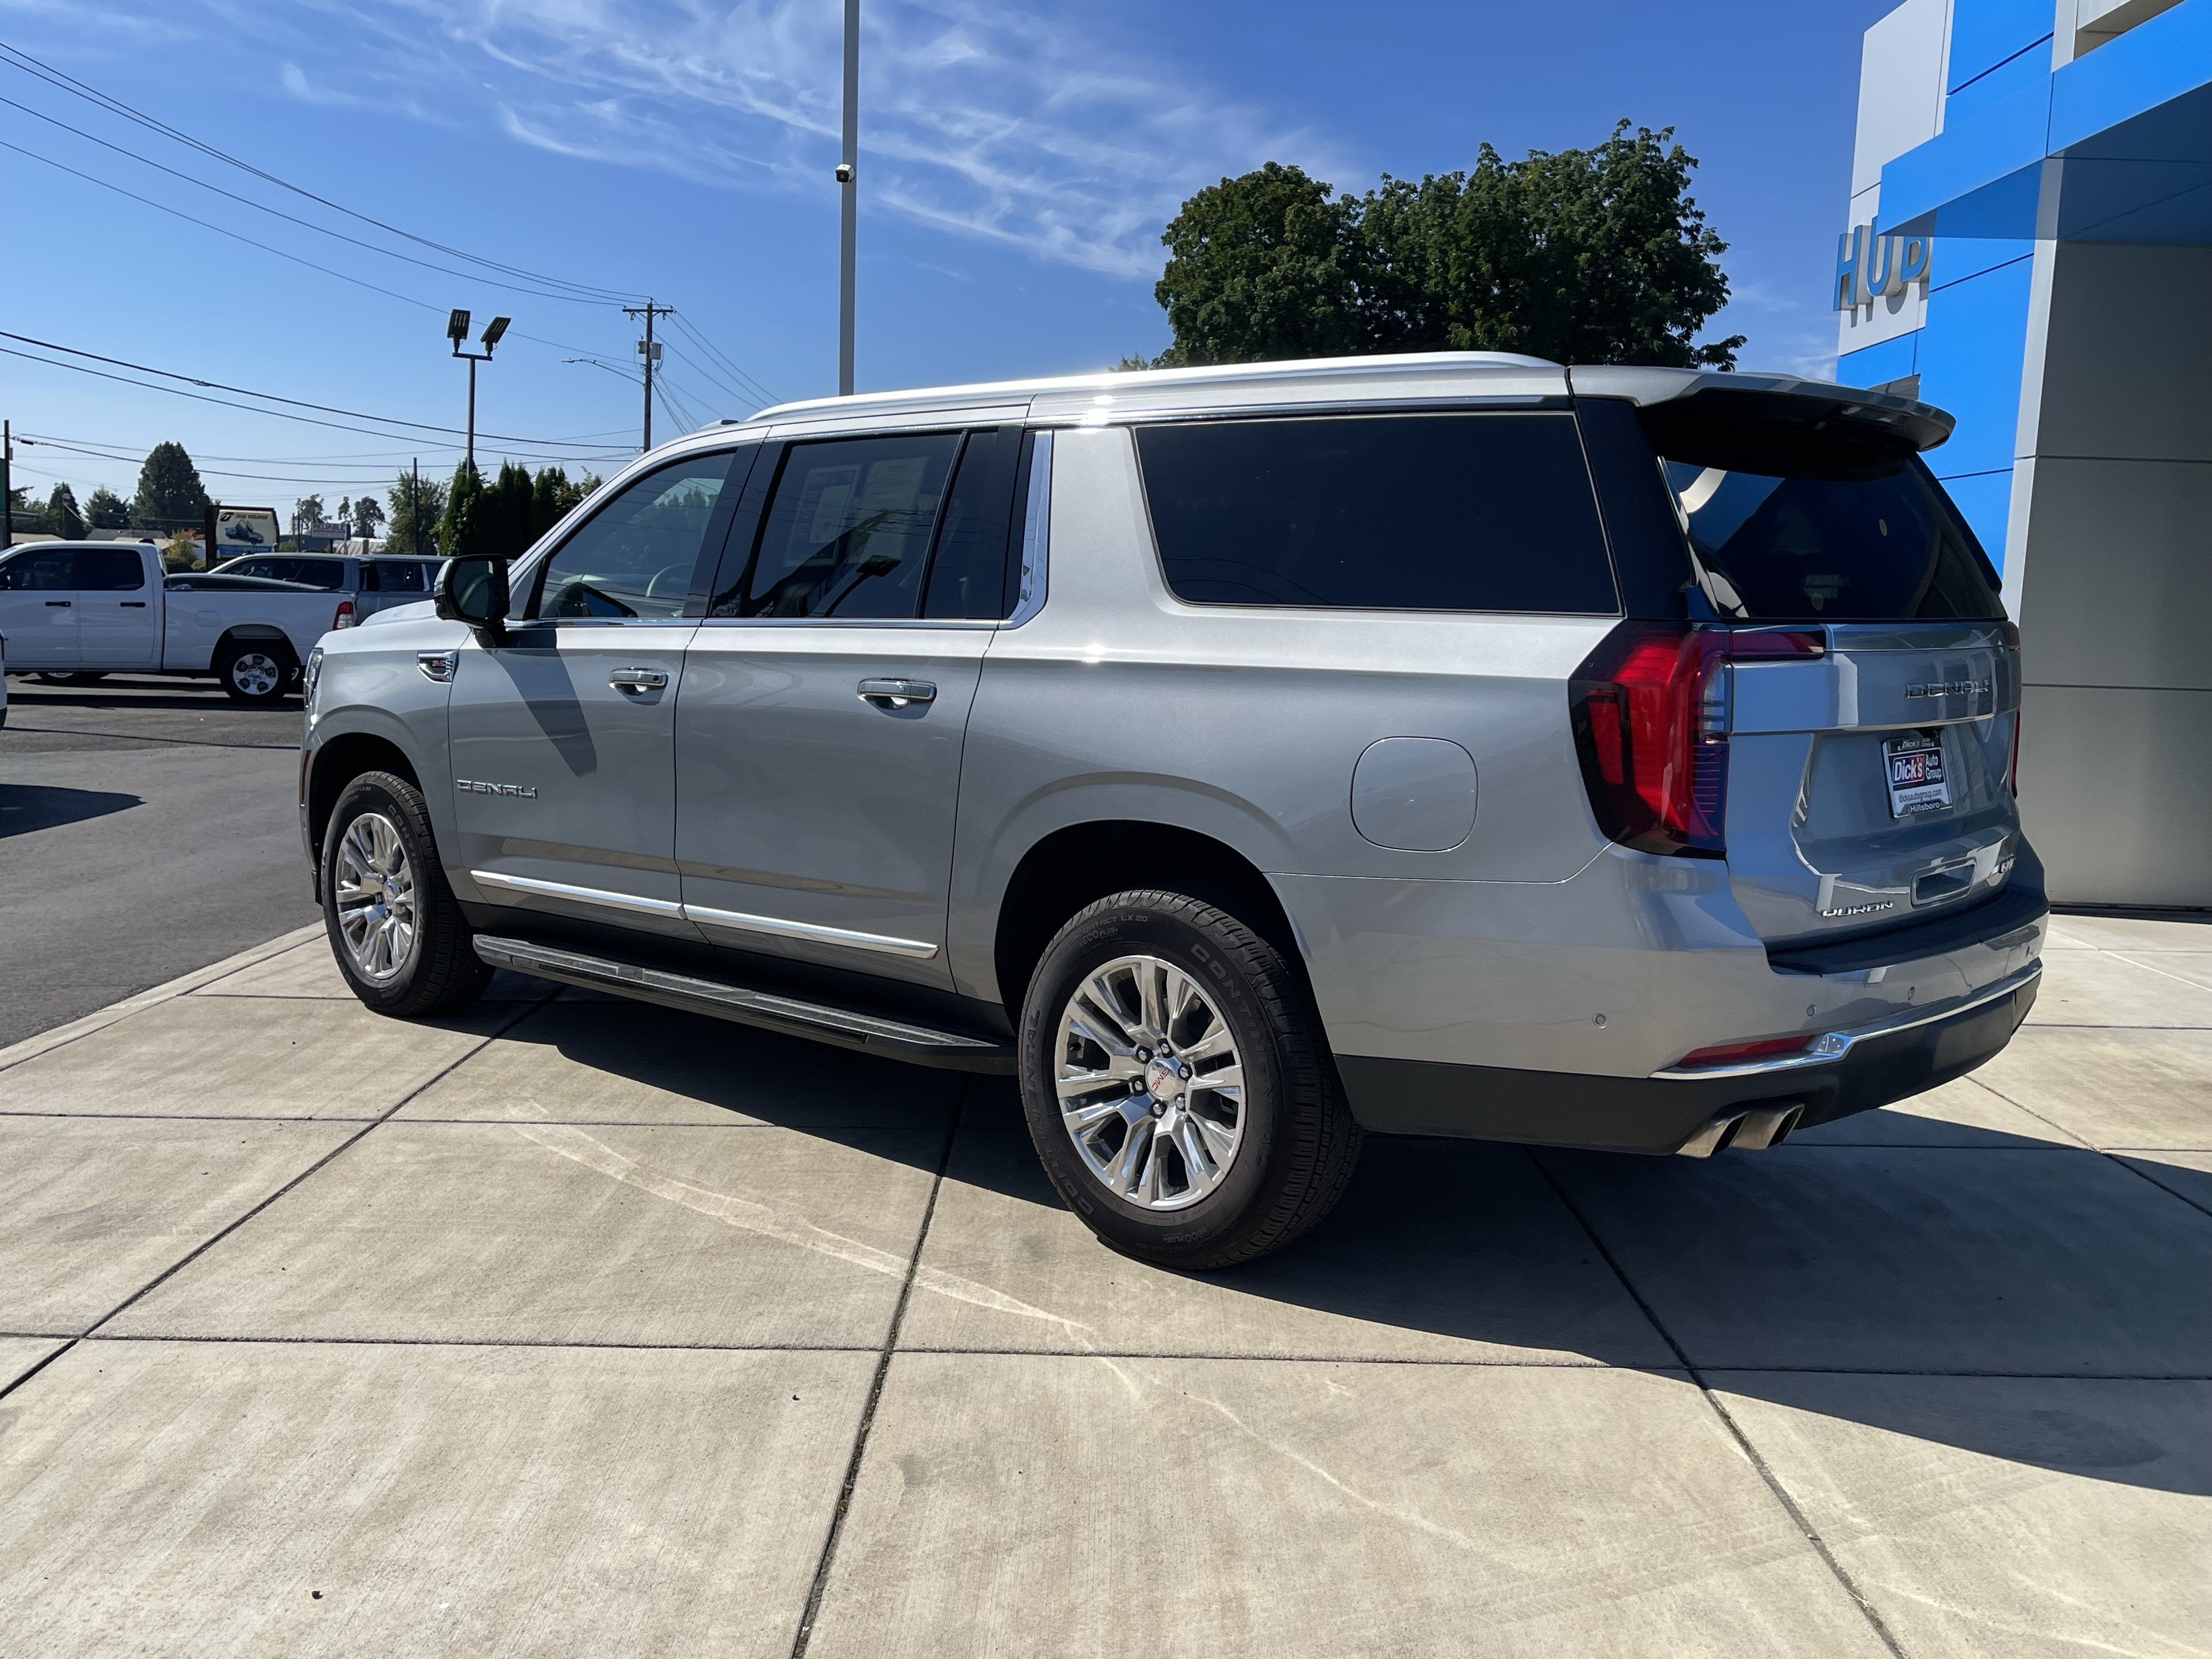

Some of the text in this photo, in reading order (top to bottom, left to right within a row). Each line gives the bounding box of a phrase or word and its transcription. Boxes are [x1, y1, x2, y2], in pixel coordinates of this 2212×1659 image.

[1905, 679, 1989, 699] DENALI
[1894, 754, 1938, 781] Dick's Auto
[1926, 768, 1942, 781] Group
[456, 779, 538, 799] DENALI
[1910, 802, 1940, 813] Hillsboro
[1821, 900, 1894, 918] YUKON
[1152, 1067, 1172, 1091] GMC
